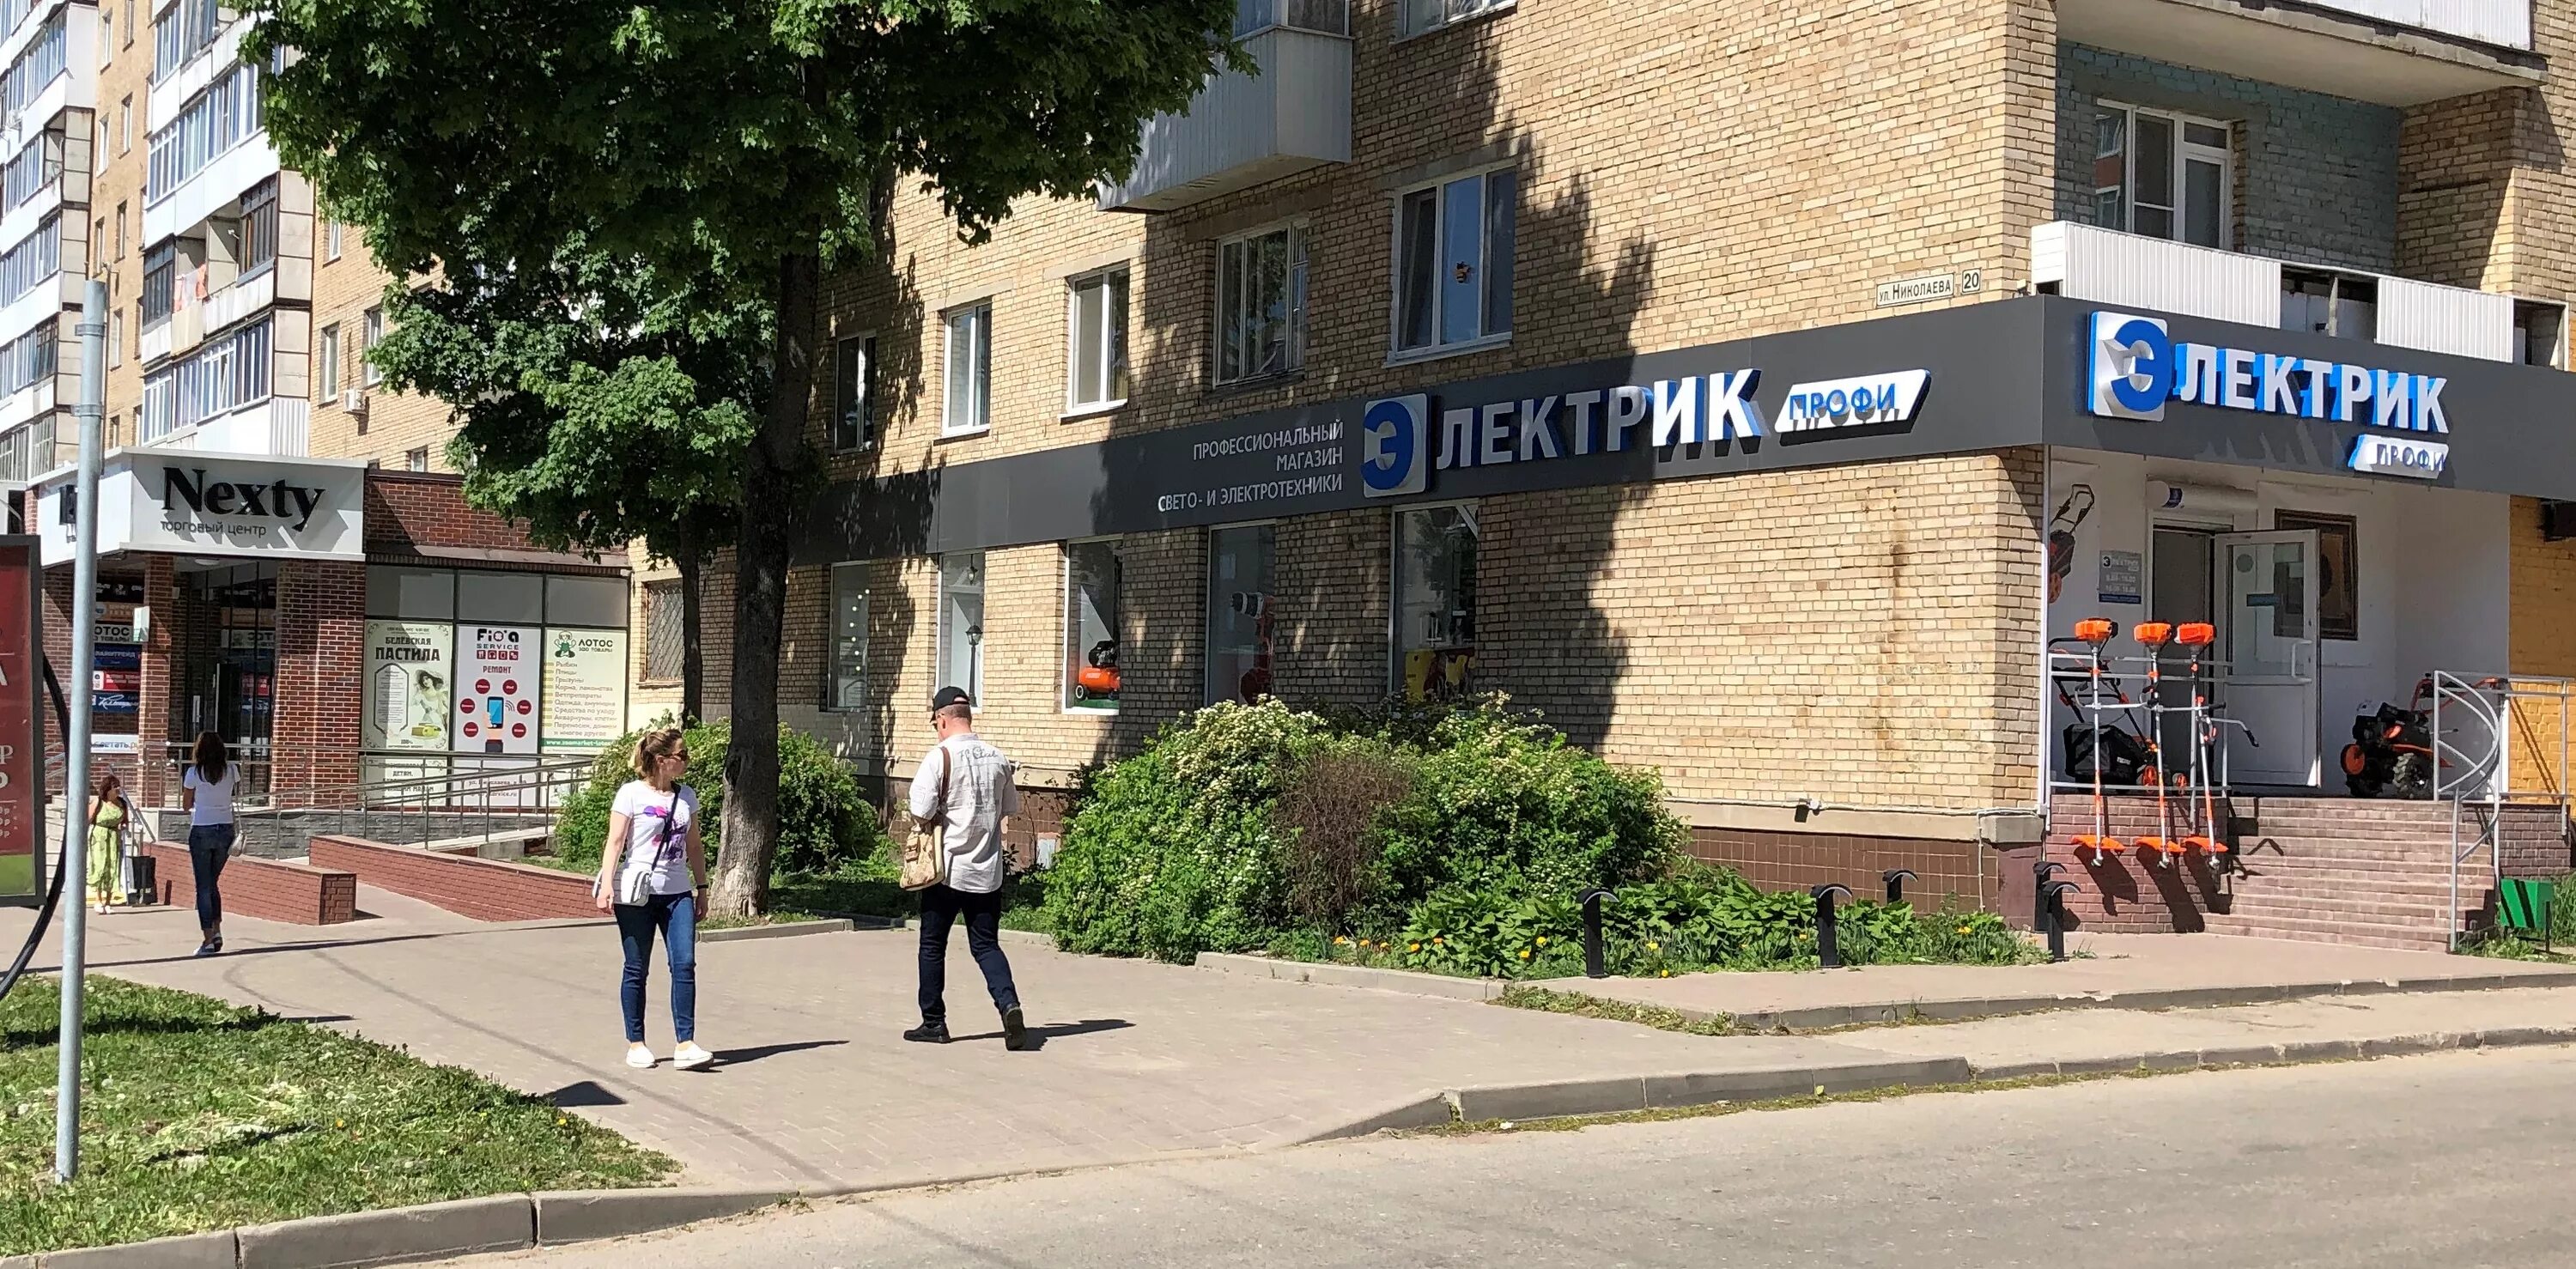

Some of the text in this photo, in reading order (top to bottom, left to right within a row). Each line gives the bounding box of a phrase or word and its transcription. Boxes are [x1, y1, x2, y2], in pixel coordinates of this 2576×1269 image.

[1880, 279, 1951, 302] ул. Николаева
[1964, 272, 1979, 289] 20
[2111, 319, 2449, 434] ЭЛЕКТРИК
[1789, 383, 1896, 421] ПРОФИ
[1193, 419, 1344, 461] ПРОФЕССИОНАЛЬНЫЙ
[1360, 367, 1761, 492] ЭЛЕКТРИК
[1276, 446, 1344, 472] МАГАЗИН
[2377, 443, 2445, 472] ПРОФИ
[162, 466, 325, 532] Nexty
[1157, 473, 1344, 513] СВЕТО- И ЭЛЕКТРОТЕХНИКИ
[161, 520, 267, 537] торговый центр
[94, 626, 131, 637] ОТОС
[375, 647, 440, 661] ПАСТИЛА
[483, 665, 512, 674] РЕМОНТ
